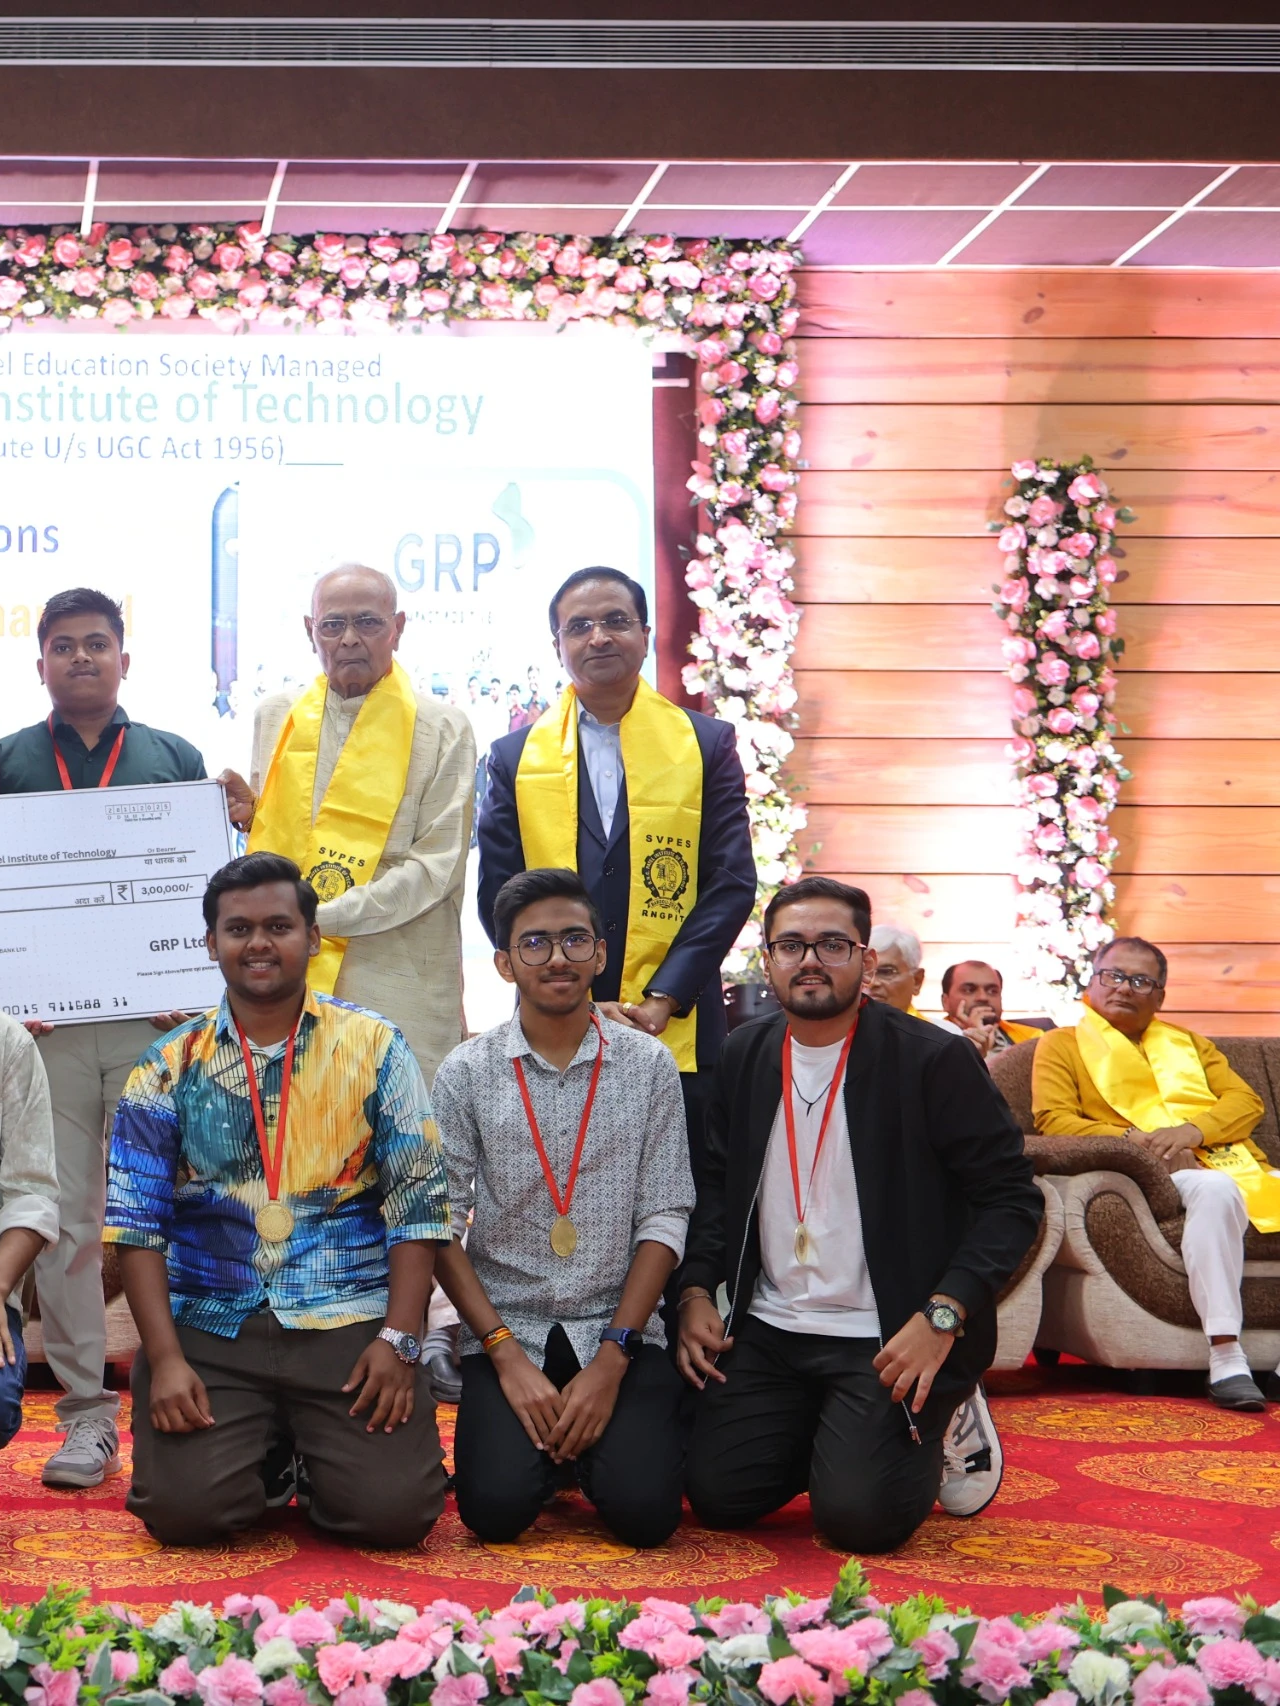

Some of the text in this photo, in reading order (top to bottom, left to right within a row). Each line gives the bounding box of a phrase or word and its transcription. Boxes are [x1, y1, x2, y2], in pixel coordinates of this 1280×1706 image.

[24, 352, 149, 376] Education
[159, 353, 252, 383] Society
[262, 353, 382, 383] Managed
[176, 380, 219, 423] of
[233, 382, 484, 435] Technology
[44, 432, 86, 464] U/s
[97, 436, 151, 459] UGC
[162, 436, 203, 459] Act
[394, 532, 501, 593] GRP
[646, 834, 692, 848] SVPES
[8, 853, 48, 864] Institute
[50, 852, 61, 860] of
[62, 848, 117, 859] Technology
[318, 846, 366, 867] SVPES
[116, 883, 194, 901] ₹ 3,00,000/-
[642, 910, 685, 923] RNGPIT
[149, 936, 207, 952] GRP Ltd
[112, 996, 128, 1008] 31
